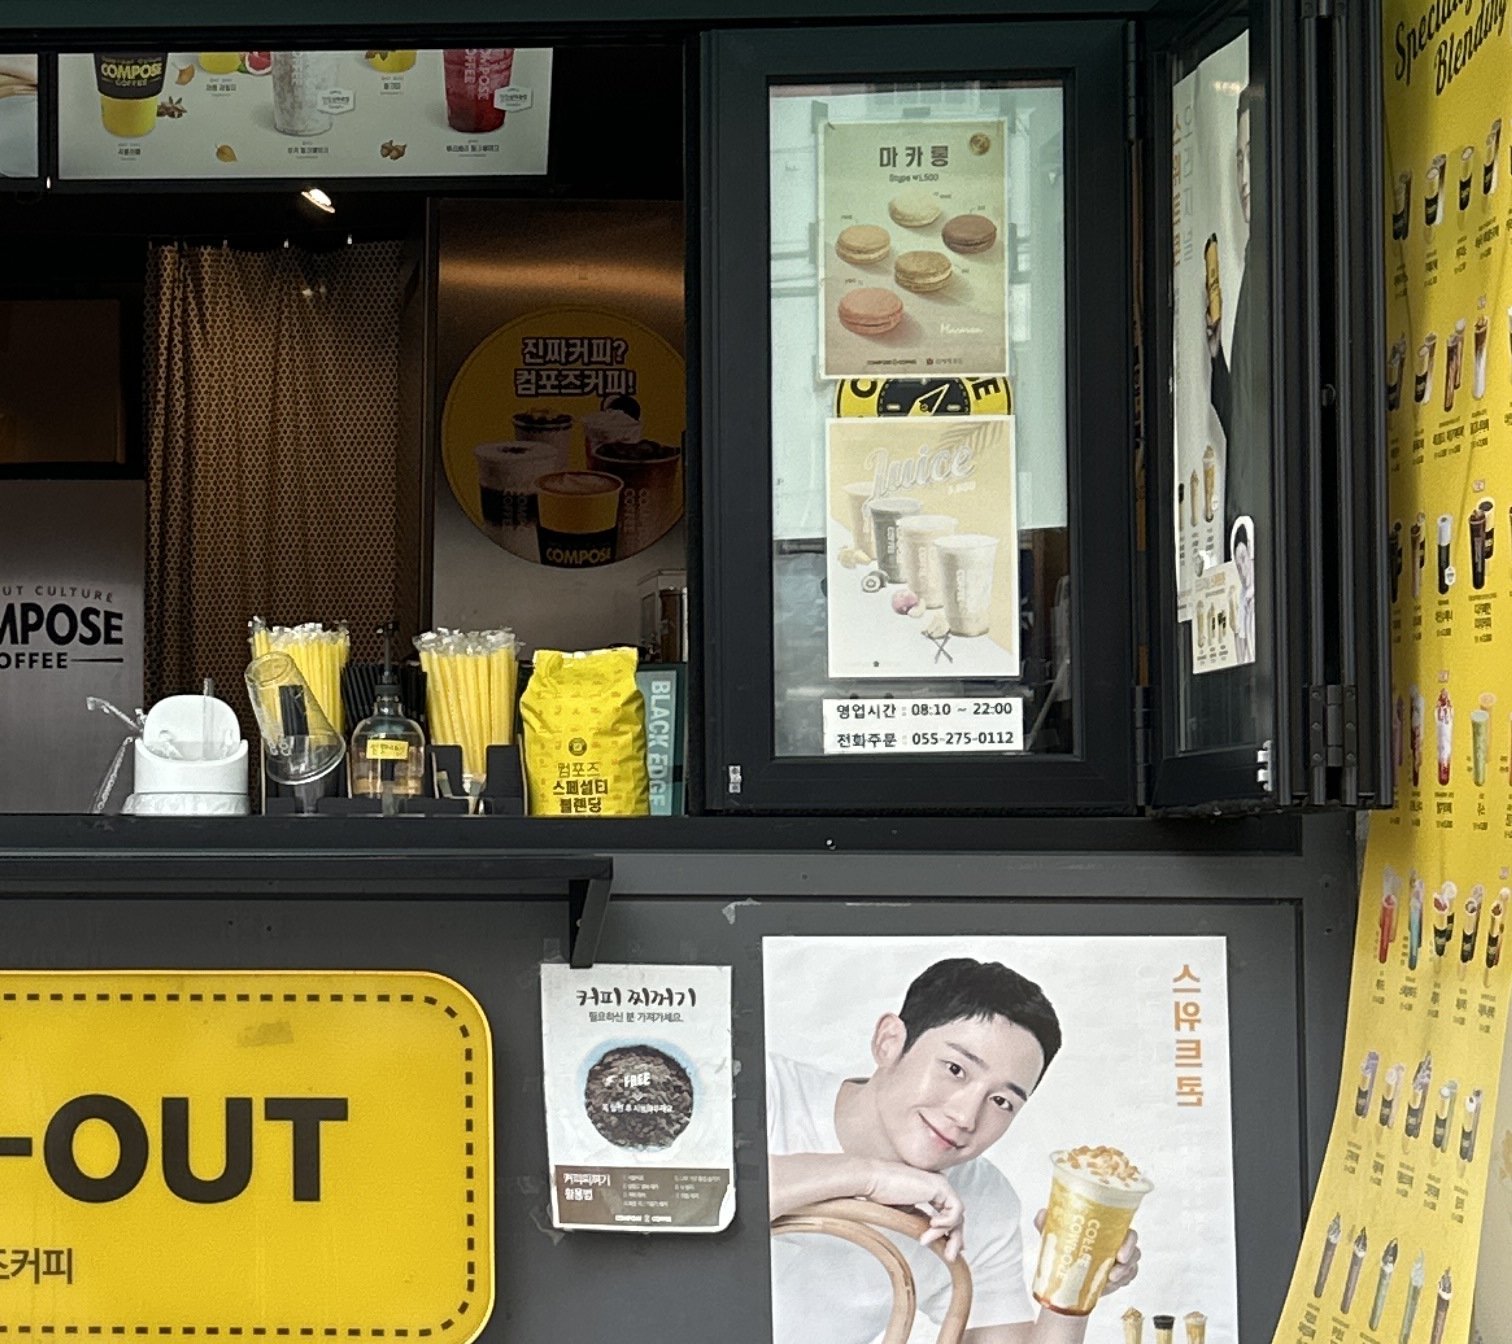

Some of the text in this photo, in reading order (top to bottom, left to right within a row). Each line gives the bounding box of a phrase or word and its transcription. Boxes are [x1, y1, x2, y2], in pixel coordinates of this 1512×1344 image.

[101, 62, 163, 81] COMPOSE
[463, 51, 476, 85] OFFEE
[478, 51, 491, 102] MPOSE
[514, 367, 636, 397] 컴포즈커피!
[862, 444, 978, 518] Juice
[34, 585, 114, 604] CULTURE
[648, 679, 672, 748] BLACK
[836, 703, 897, 720] 영업시간
[910, 702, 952, 717] 08:10
[972, 702, 1013, 717] 22:00
[836, 732, 898, 749] 전화주문
[911, 731, 1014, 747] 055-275-0112
[557, 762, 601, 779] 컴포즈
[575, 986, 697, 1008] 커피 찌꺼기
